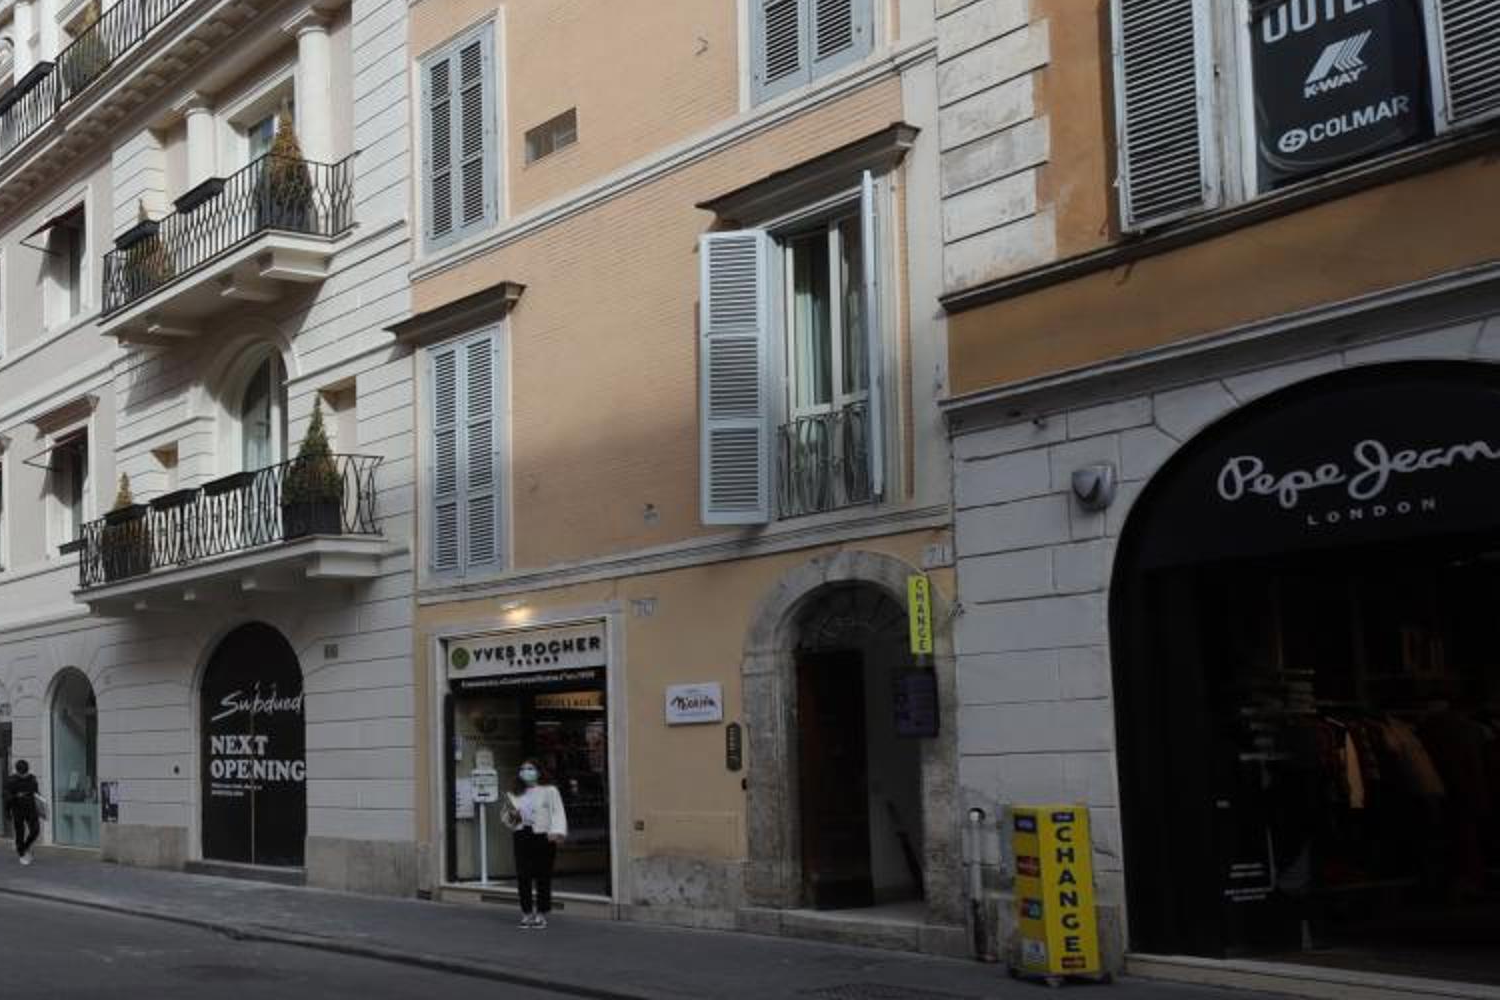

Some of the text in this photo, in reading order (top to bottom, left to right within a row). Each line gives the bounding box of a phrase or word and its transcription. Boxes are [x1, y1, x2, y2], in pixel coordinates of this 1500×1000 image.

[1309, 95, 1410, 142] COLMAR
[1217, 439, 1500, 509] Pepe Jean
[1305, 496, 1438, 526] LONDON
[473, 645, 517, 663] YVES
[521, 636, 601, 658] ROCHER
[211, 680, 304, 722] Subdued
[210, 735, 268, 755] NEXT
[211, 759, 306, 782] OPENING
[1055, 826, 1080, 953] CHANGE
